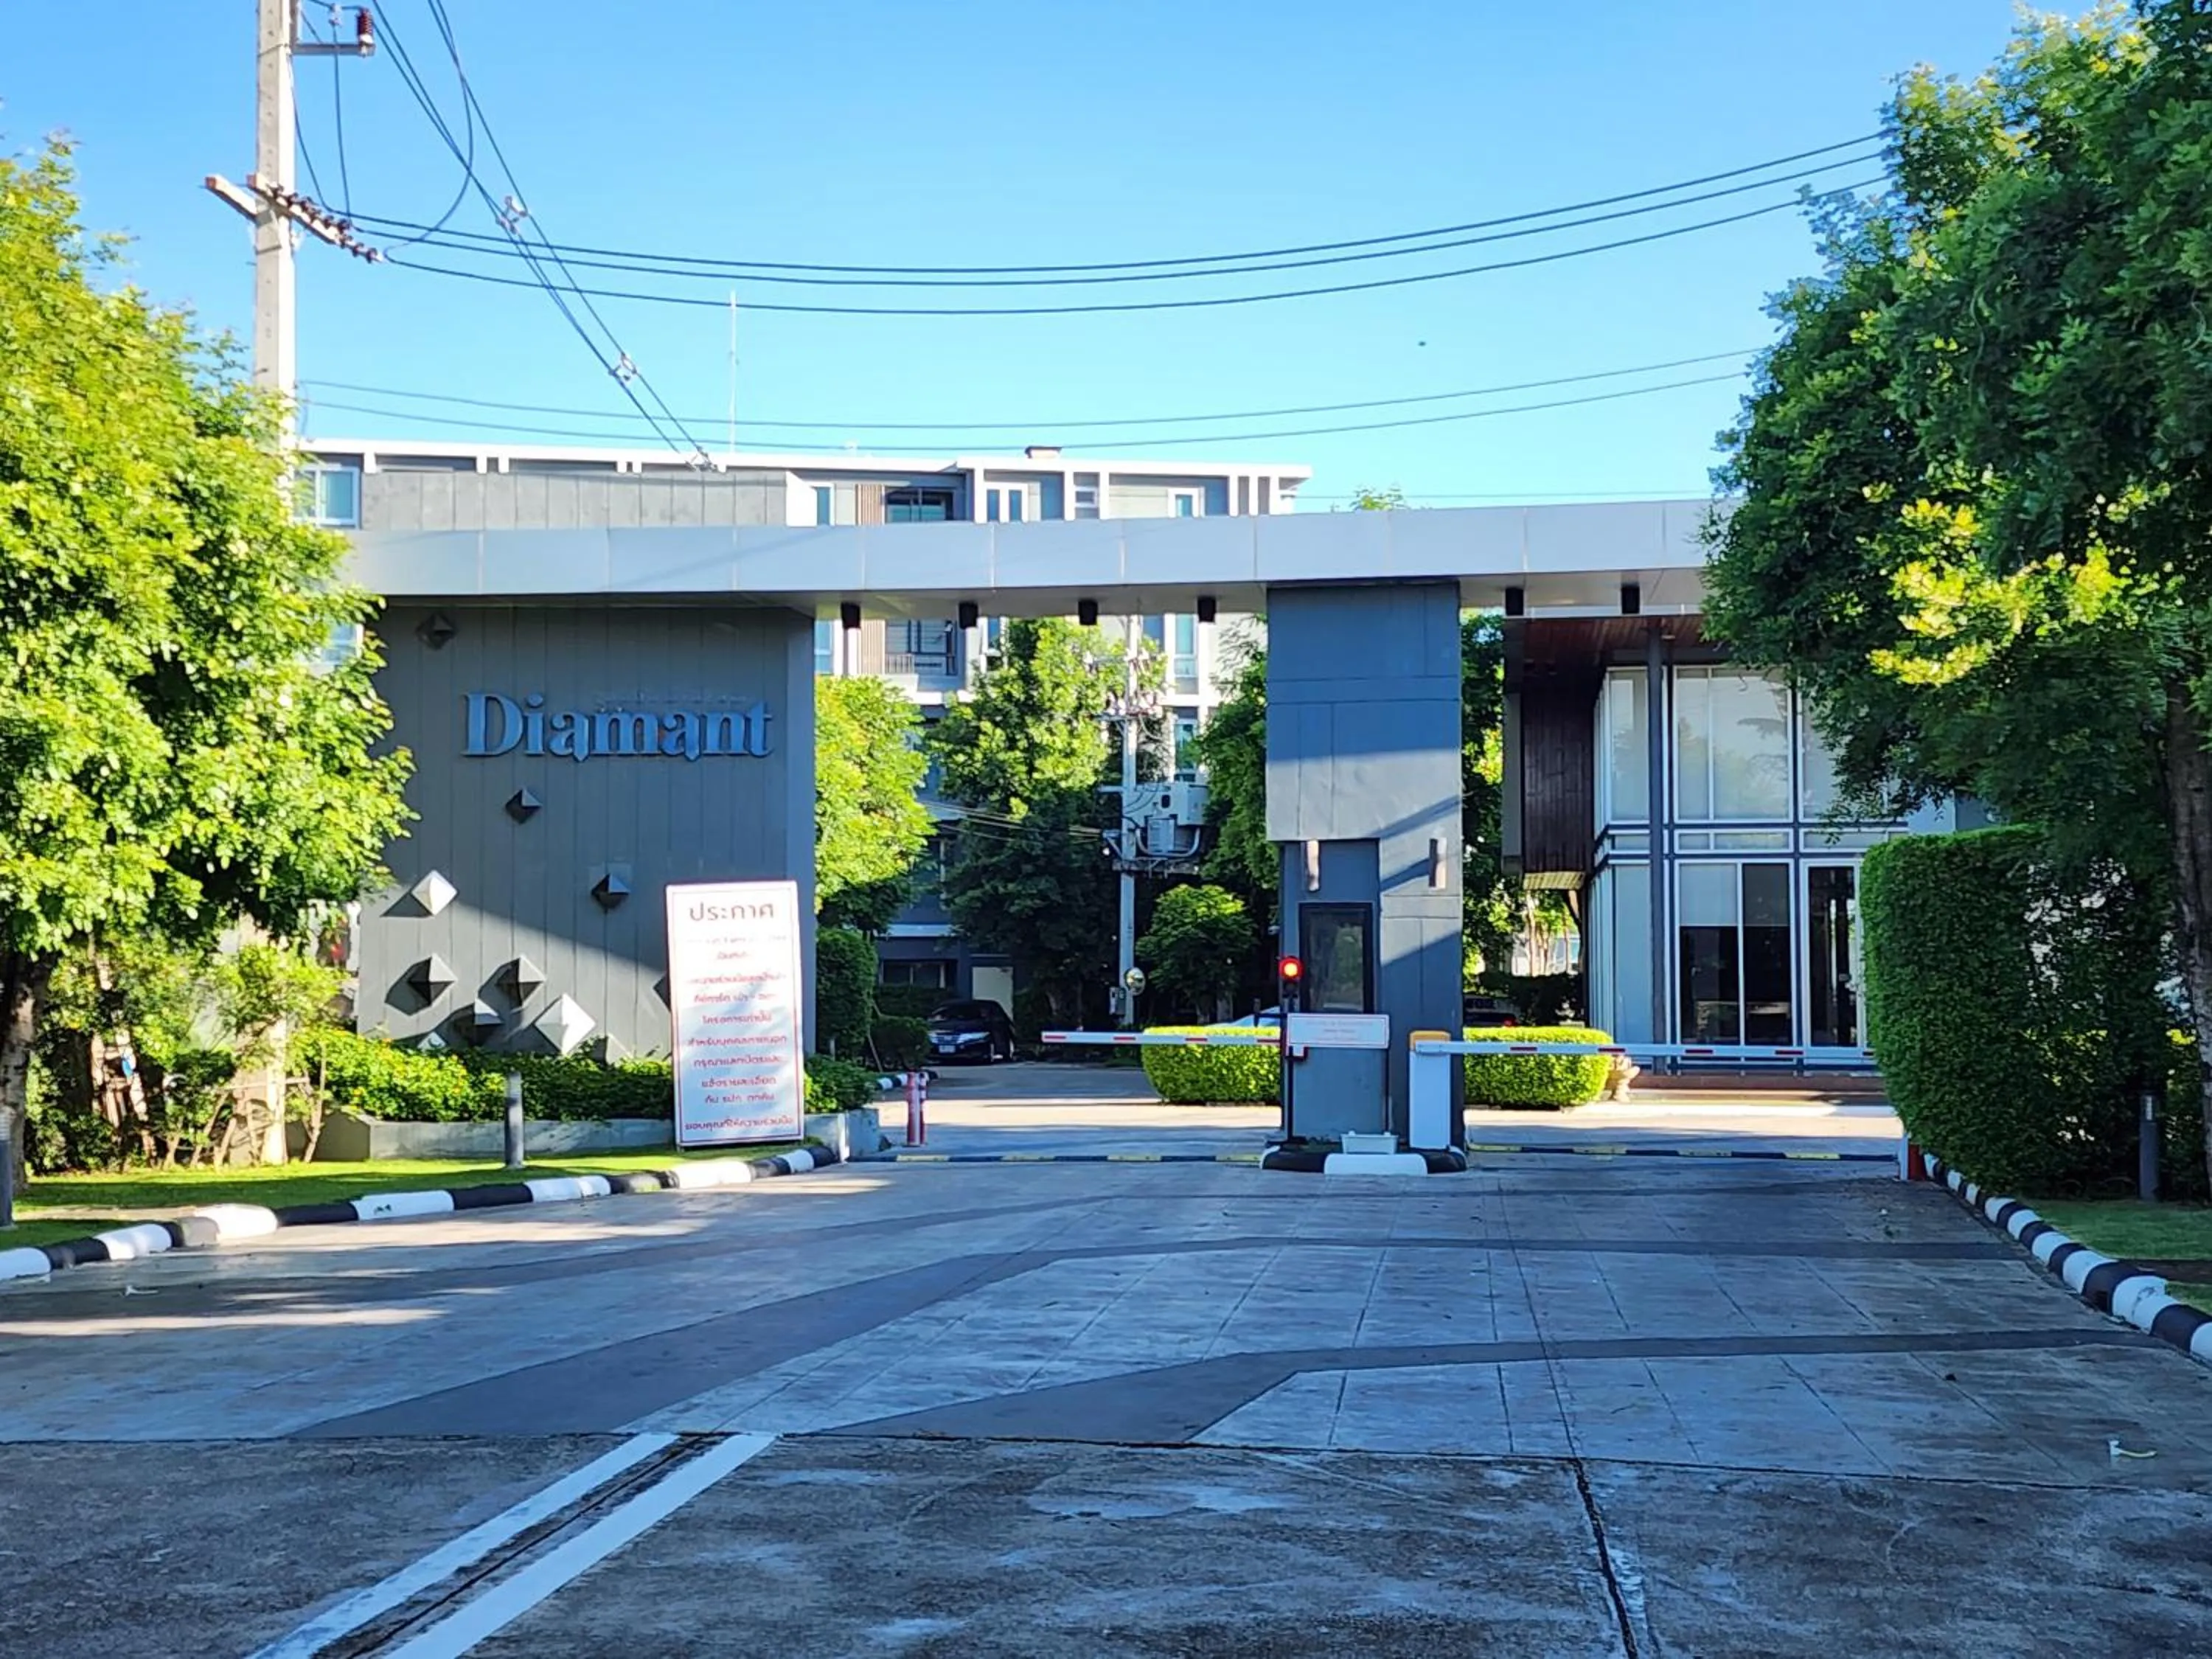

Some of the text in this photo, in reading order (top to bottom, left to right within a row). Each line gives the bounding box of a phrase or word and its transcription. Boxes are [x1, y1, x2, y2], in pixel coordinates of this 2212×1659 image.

[460, 692, 774, 762] Diamant
[689, 902, 773, 921] ประกาศ
